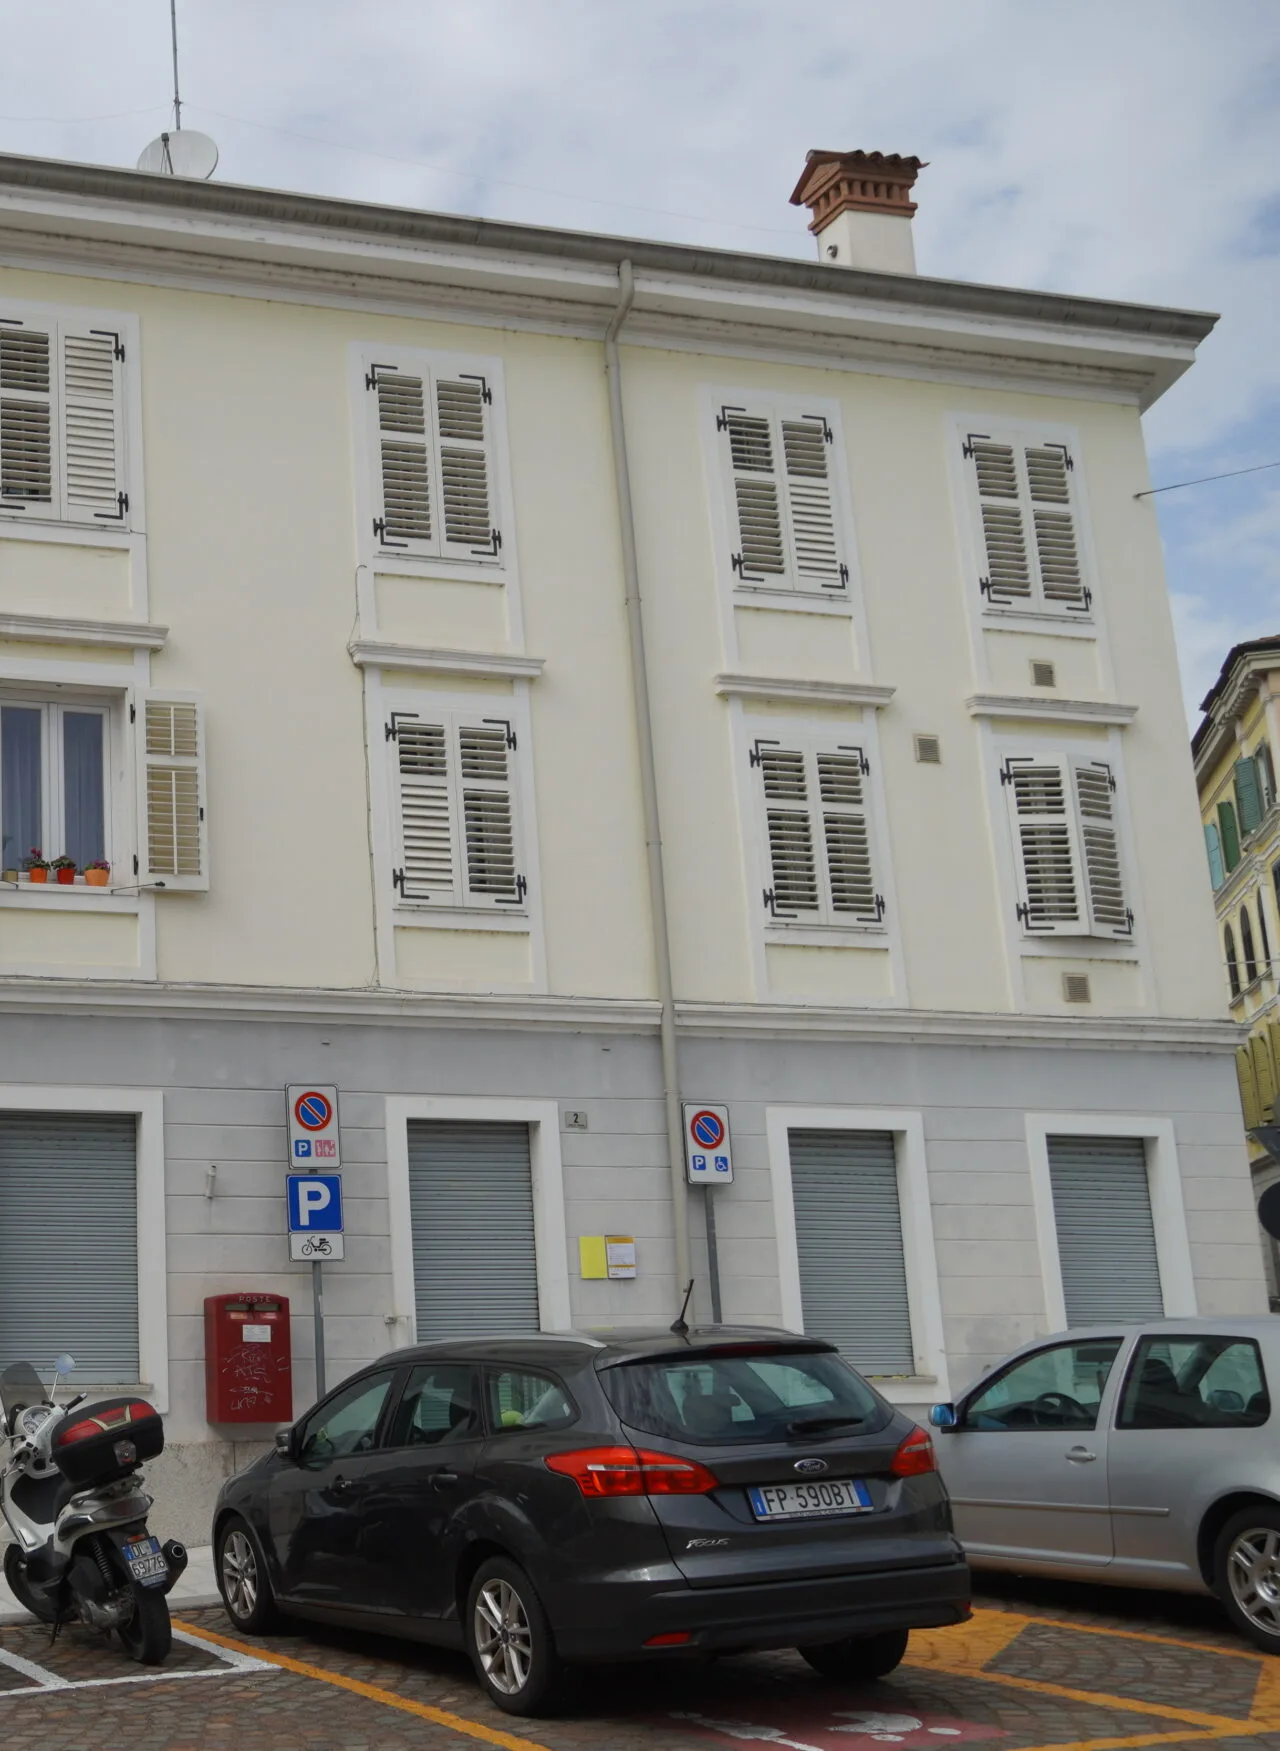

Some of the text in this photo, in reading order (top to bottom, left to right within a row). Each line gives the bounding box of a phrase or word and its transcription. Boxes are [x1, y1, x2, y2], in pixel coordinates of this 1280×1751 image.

[573, 1112, 579, 1123] 2
[298, 1142, 308, 1155] P
[694, 1156, 704, 1169] P
[298, 1181, 331, 1226] P
[239, 1295, 272, 1303] POSTE
[795, 1482, 855, 1509] 590BT
[132, 1555, 166, 1576] 69776
